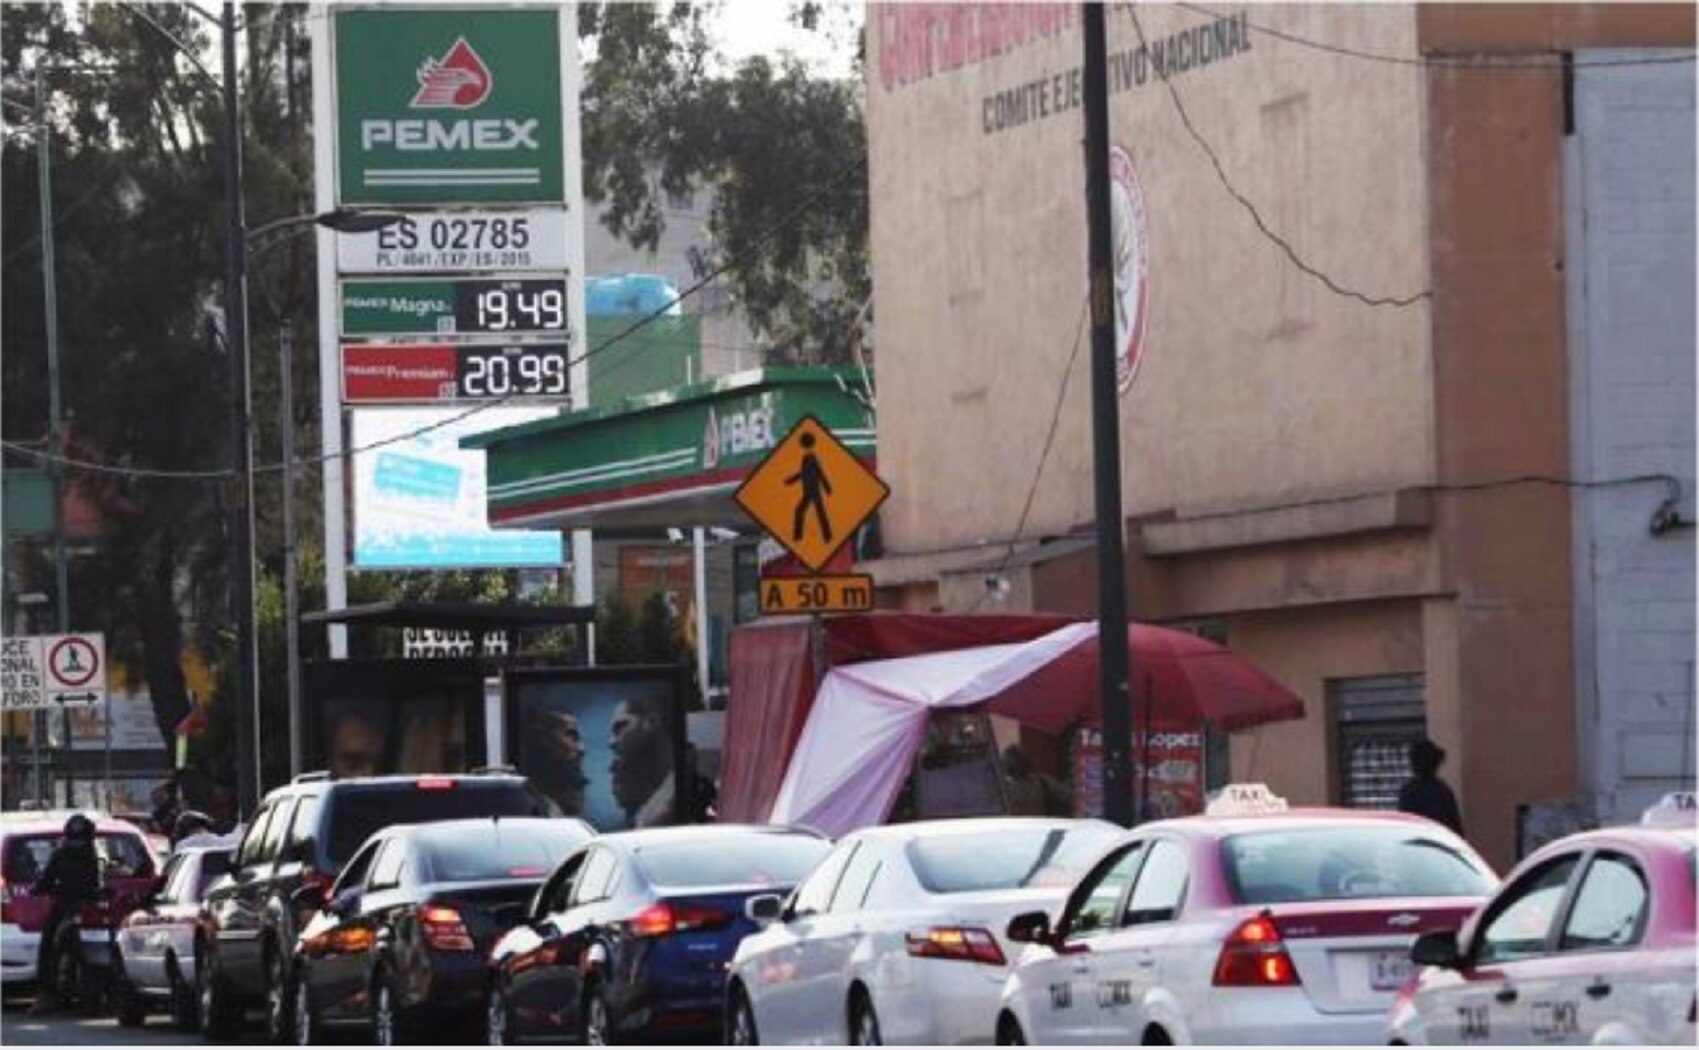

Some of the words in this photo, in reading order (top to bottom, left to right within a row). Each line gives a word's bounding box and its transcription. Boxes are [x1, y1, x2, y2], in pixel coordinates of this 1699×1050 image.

[1052, 44, 1147, 113] EJETIVO
[1151, 10, 1252, 83] NACIONAL
[361, 119, 540, 151] PEMEX
[377, 219, 419, 249] ES
[431, 219, 529, 249] 02785
[478, 290, 563, 329] 19.49
[465, 355, 564, 394] 20.99
[767, 583, 784, 607] A
[797, 583, 827, 607] 50
[842, 586, 866, 606] m
[1230, 789, 1266, 803] TAXI
